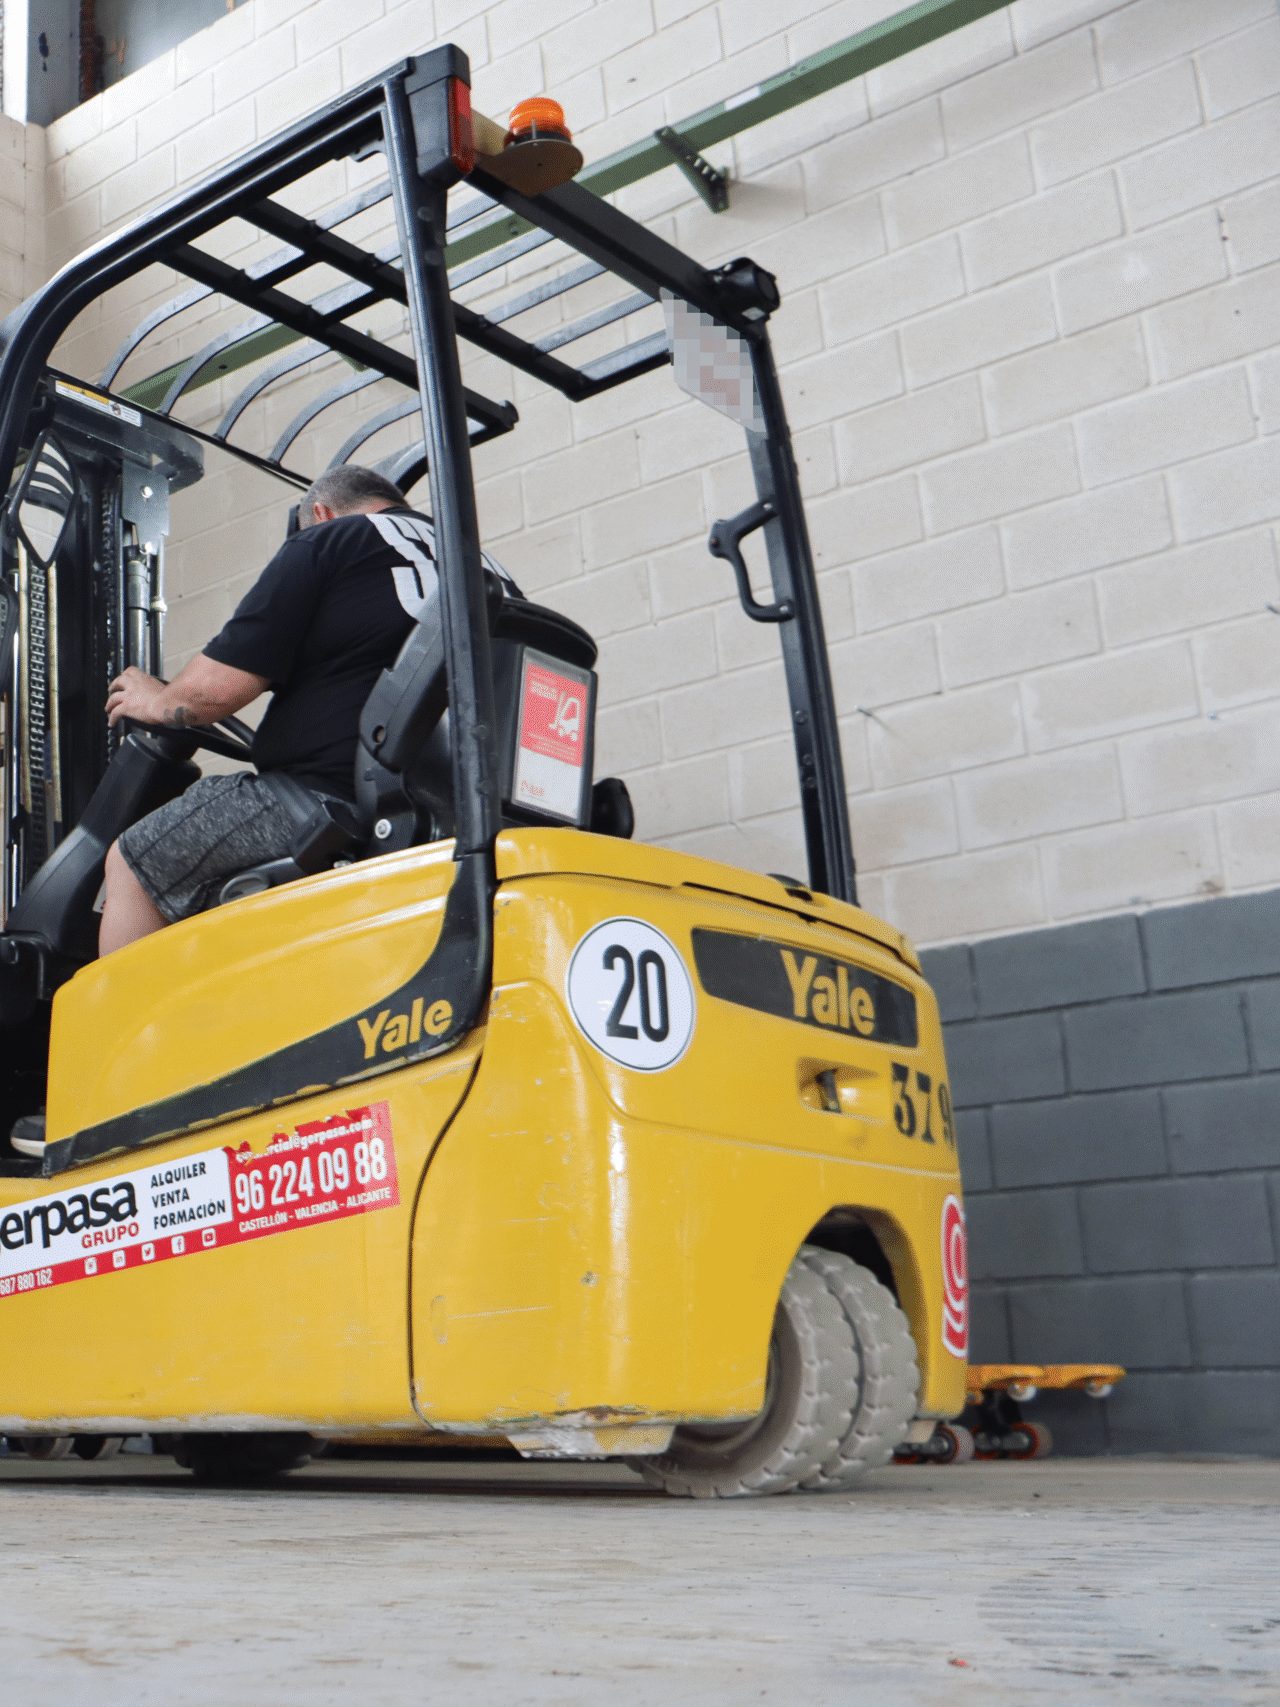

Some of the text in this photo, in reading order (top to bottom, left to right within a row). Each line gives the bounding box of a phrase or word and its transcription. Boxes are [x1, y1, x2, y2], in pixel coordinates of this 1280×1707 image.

[601, 943, 671, 1043] 20
[780, 950, 875, 1035] Yale
[356, 997, 453, 1060] Yale
[150, 1161, 207, 1189] ALQUILER
[235, 1137, 388, 1214] 96 224 09 88
[151, 1188, 191, 1209] VENTA
[153, 1197, 227, 1231] FORMACIÓN
[238, 1210, 289, 1233] CASTELLÓN
[294, 1200, 339, 1220] VALENCIA
[346, 1187, 392, 1208] ALICANTE
[81, 1221, 140, 1249] GRUPO
[35, 1267, 54, 1287] 162
